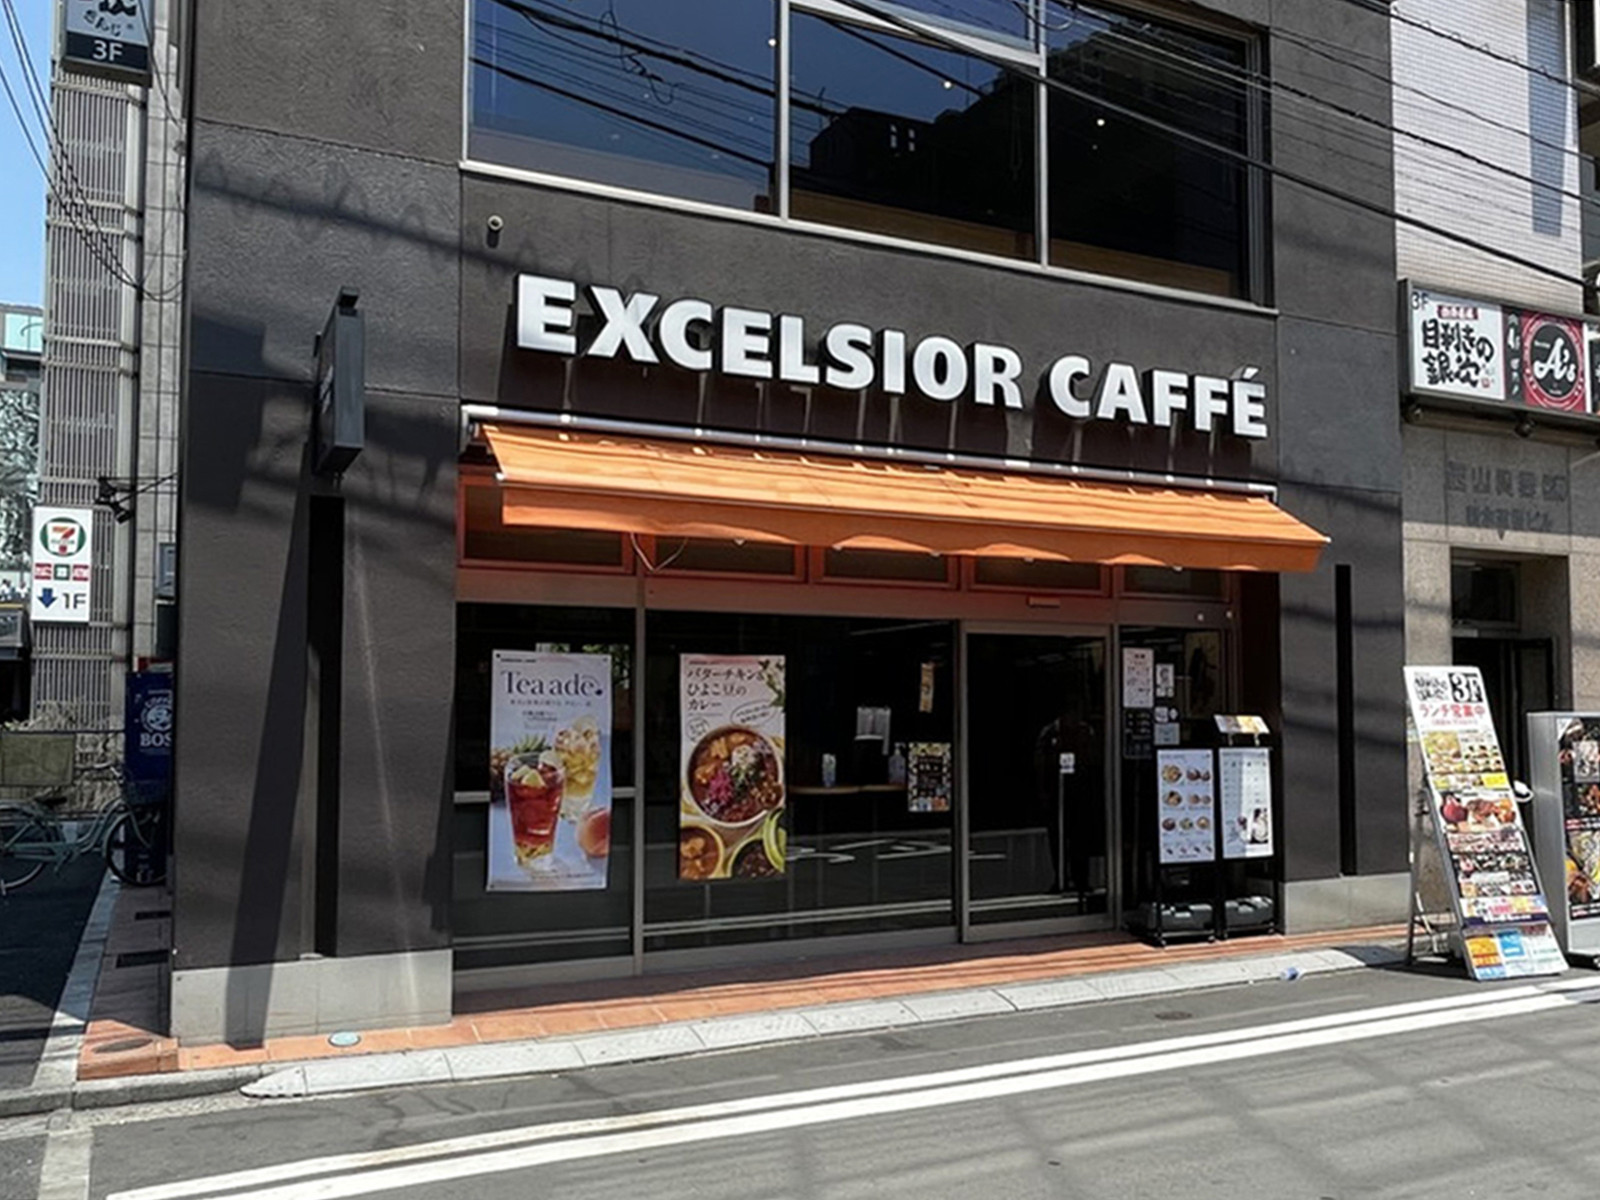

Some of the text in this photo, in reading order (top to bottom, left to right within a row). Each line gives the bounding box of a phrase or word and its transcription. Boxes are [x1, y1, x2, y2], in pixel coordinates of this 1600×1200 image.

[92, 40, 123, 61] 3F
[1411, 291, 1428, 310] 3F
[1422, 319, 1494, 362] 目利きの
[517, 273, 1268, 438] EXCELSIOR CAFFÉ
[1422, 351, 1480, 388] 銀次
[63, 593, 87, 609] 1F
[501, 671, 544, 696] Tea
[1451, 672, 1481, 702] 3F
